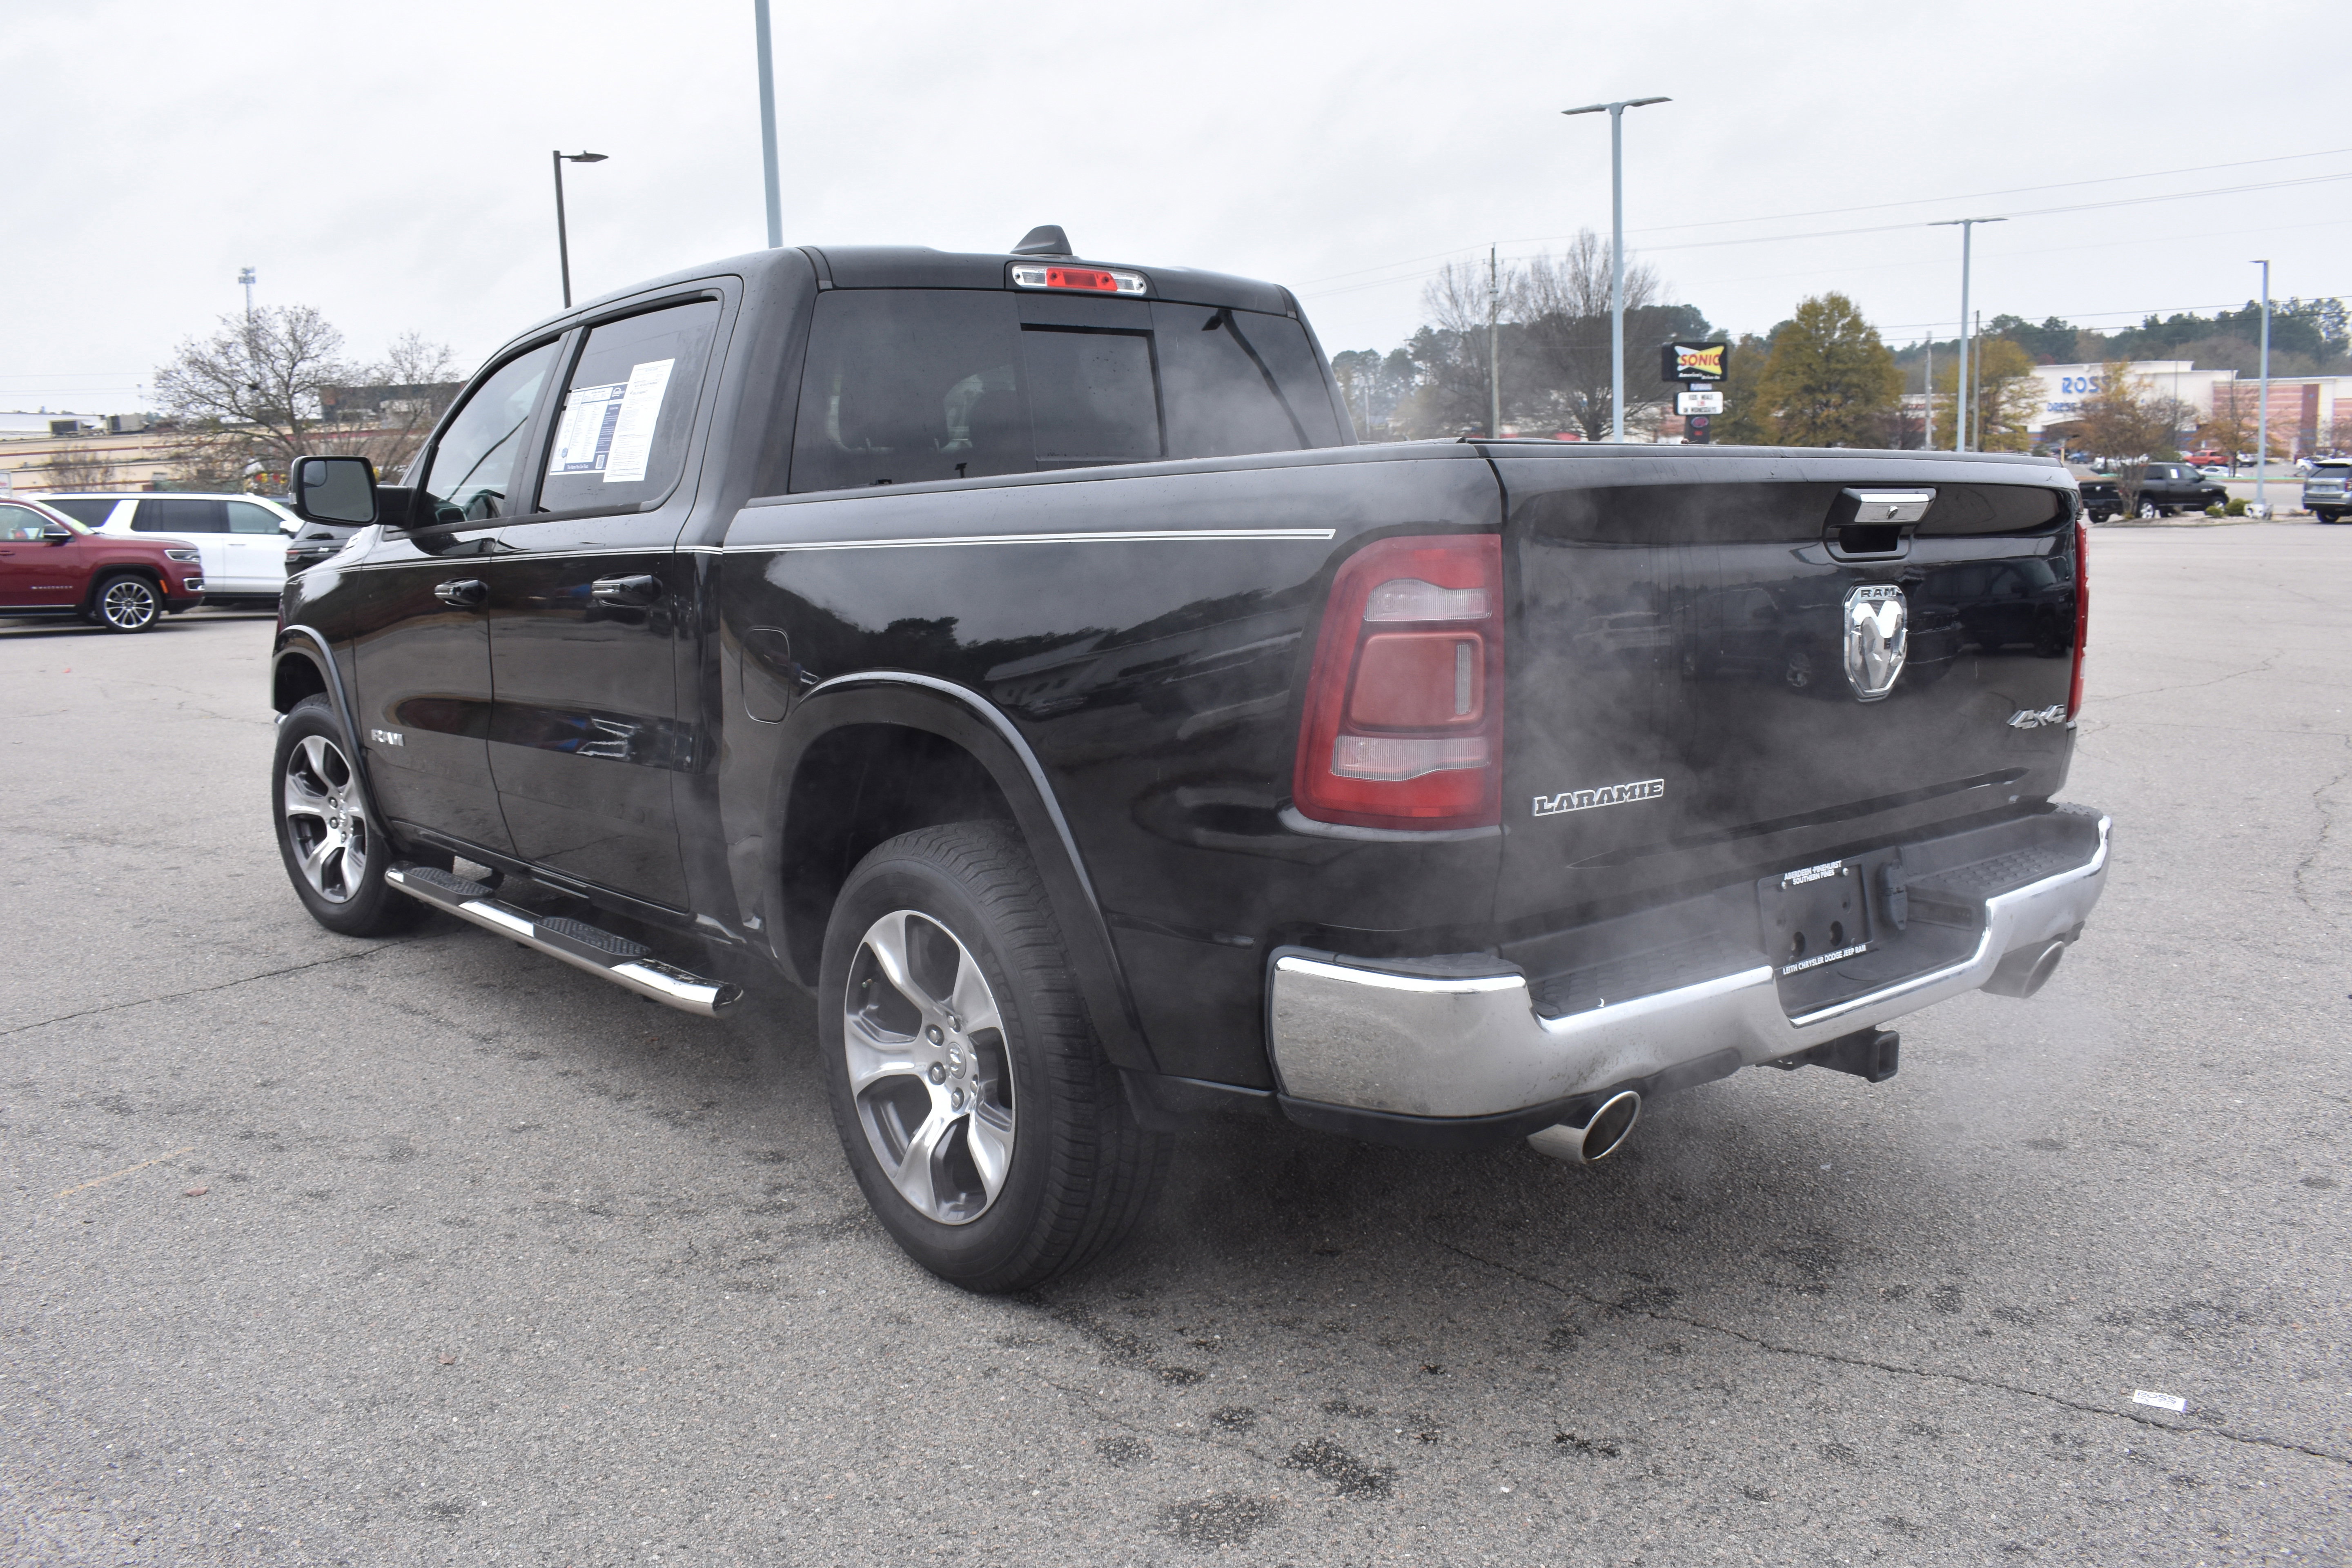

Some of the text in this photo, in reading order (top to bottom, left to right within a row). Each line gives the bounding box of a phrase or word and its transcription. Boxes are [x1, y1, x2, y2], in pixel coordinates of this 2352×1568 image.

[1680, 354, 1721, 366] SONIC
[1860, 588, 1897, 598] RAM
[371, 728, 405, 747] RAM
[1531, 778, 1664, 817] LARAMIE
[1793, 869, 1835, 885] SOUTHERN PINES
[1783, 944, 1866, 975] LEITH CHRYSLER DODGE JEEP RAM
[2137, 1391, 2177, 1404] ROSS
